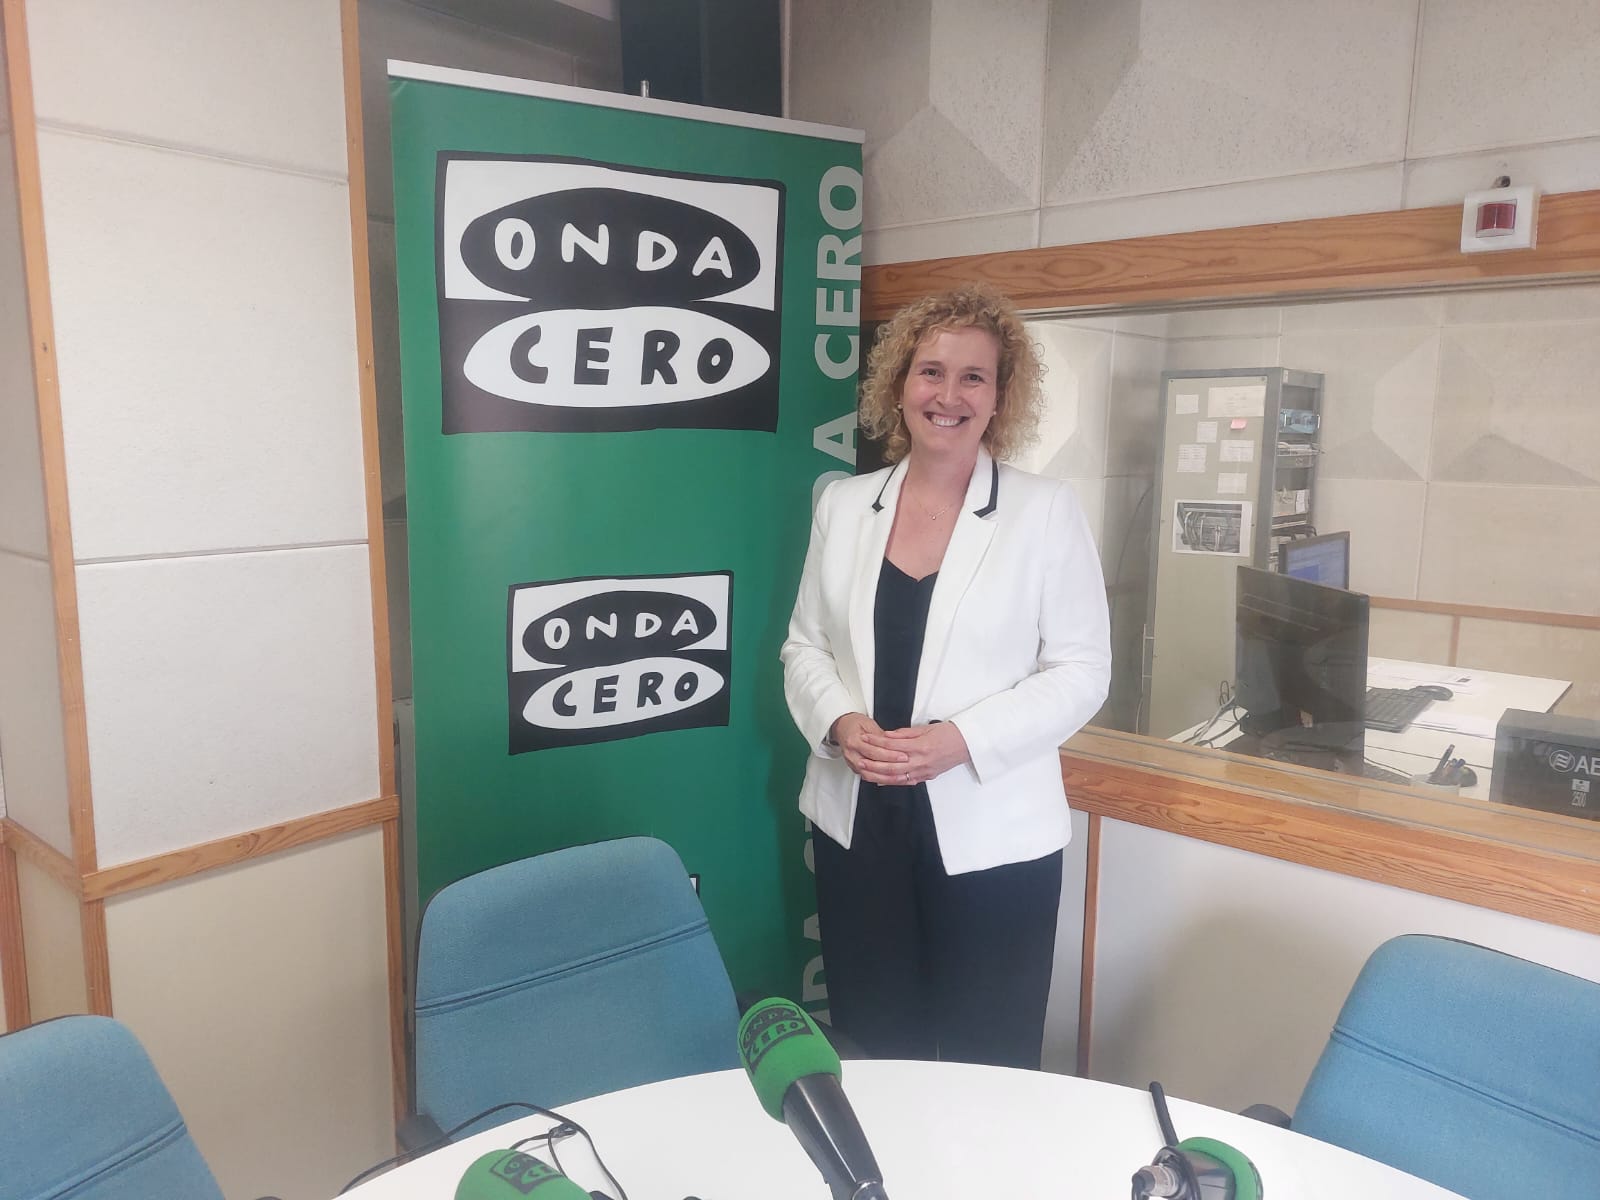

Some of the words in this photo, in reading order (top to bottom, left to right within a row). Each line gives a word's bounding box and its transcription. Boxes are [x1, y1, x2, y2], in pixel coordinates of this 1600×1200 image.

[494, 217, 733, 279] ONDA
[814, 166, 864, 380] CERO
[510, 324, 734, 386] CERO
[543, 609, 699, 650] ONDA
[552, 671, 699, 717] CERO
[745, 1010, 797, 1041] ONDA
[752, 1021, 799, 1054] CERO
